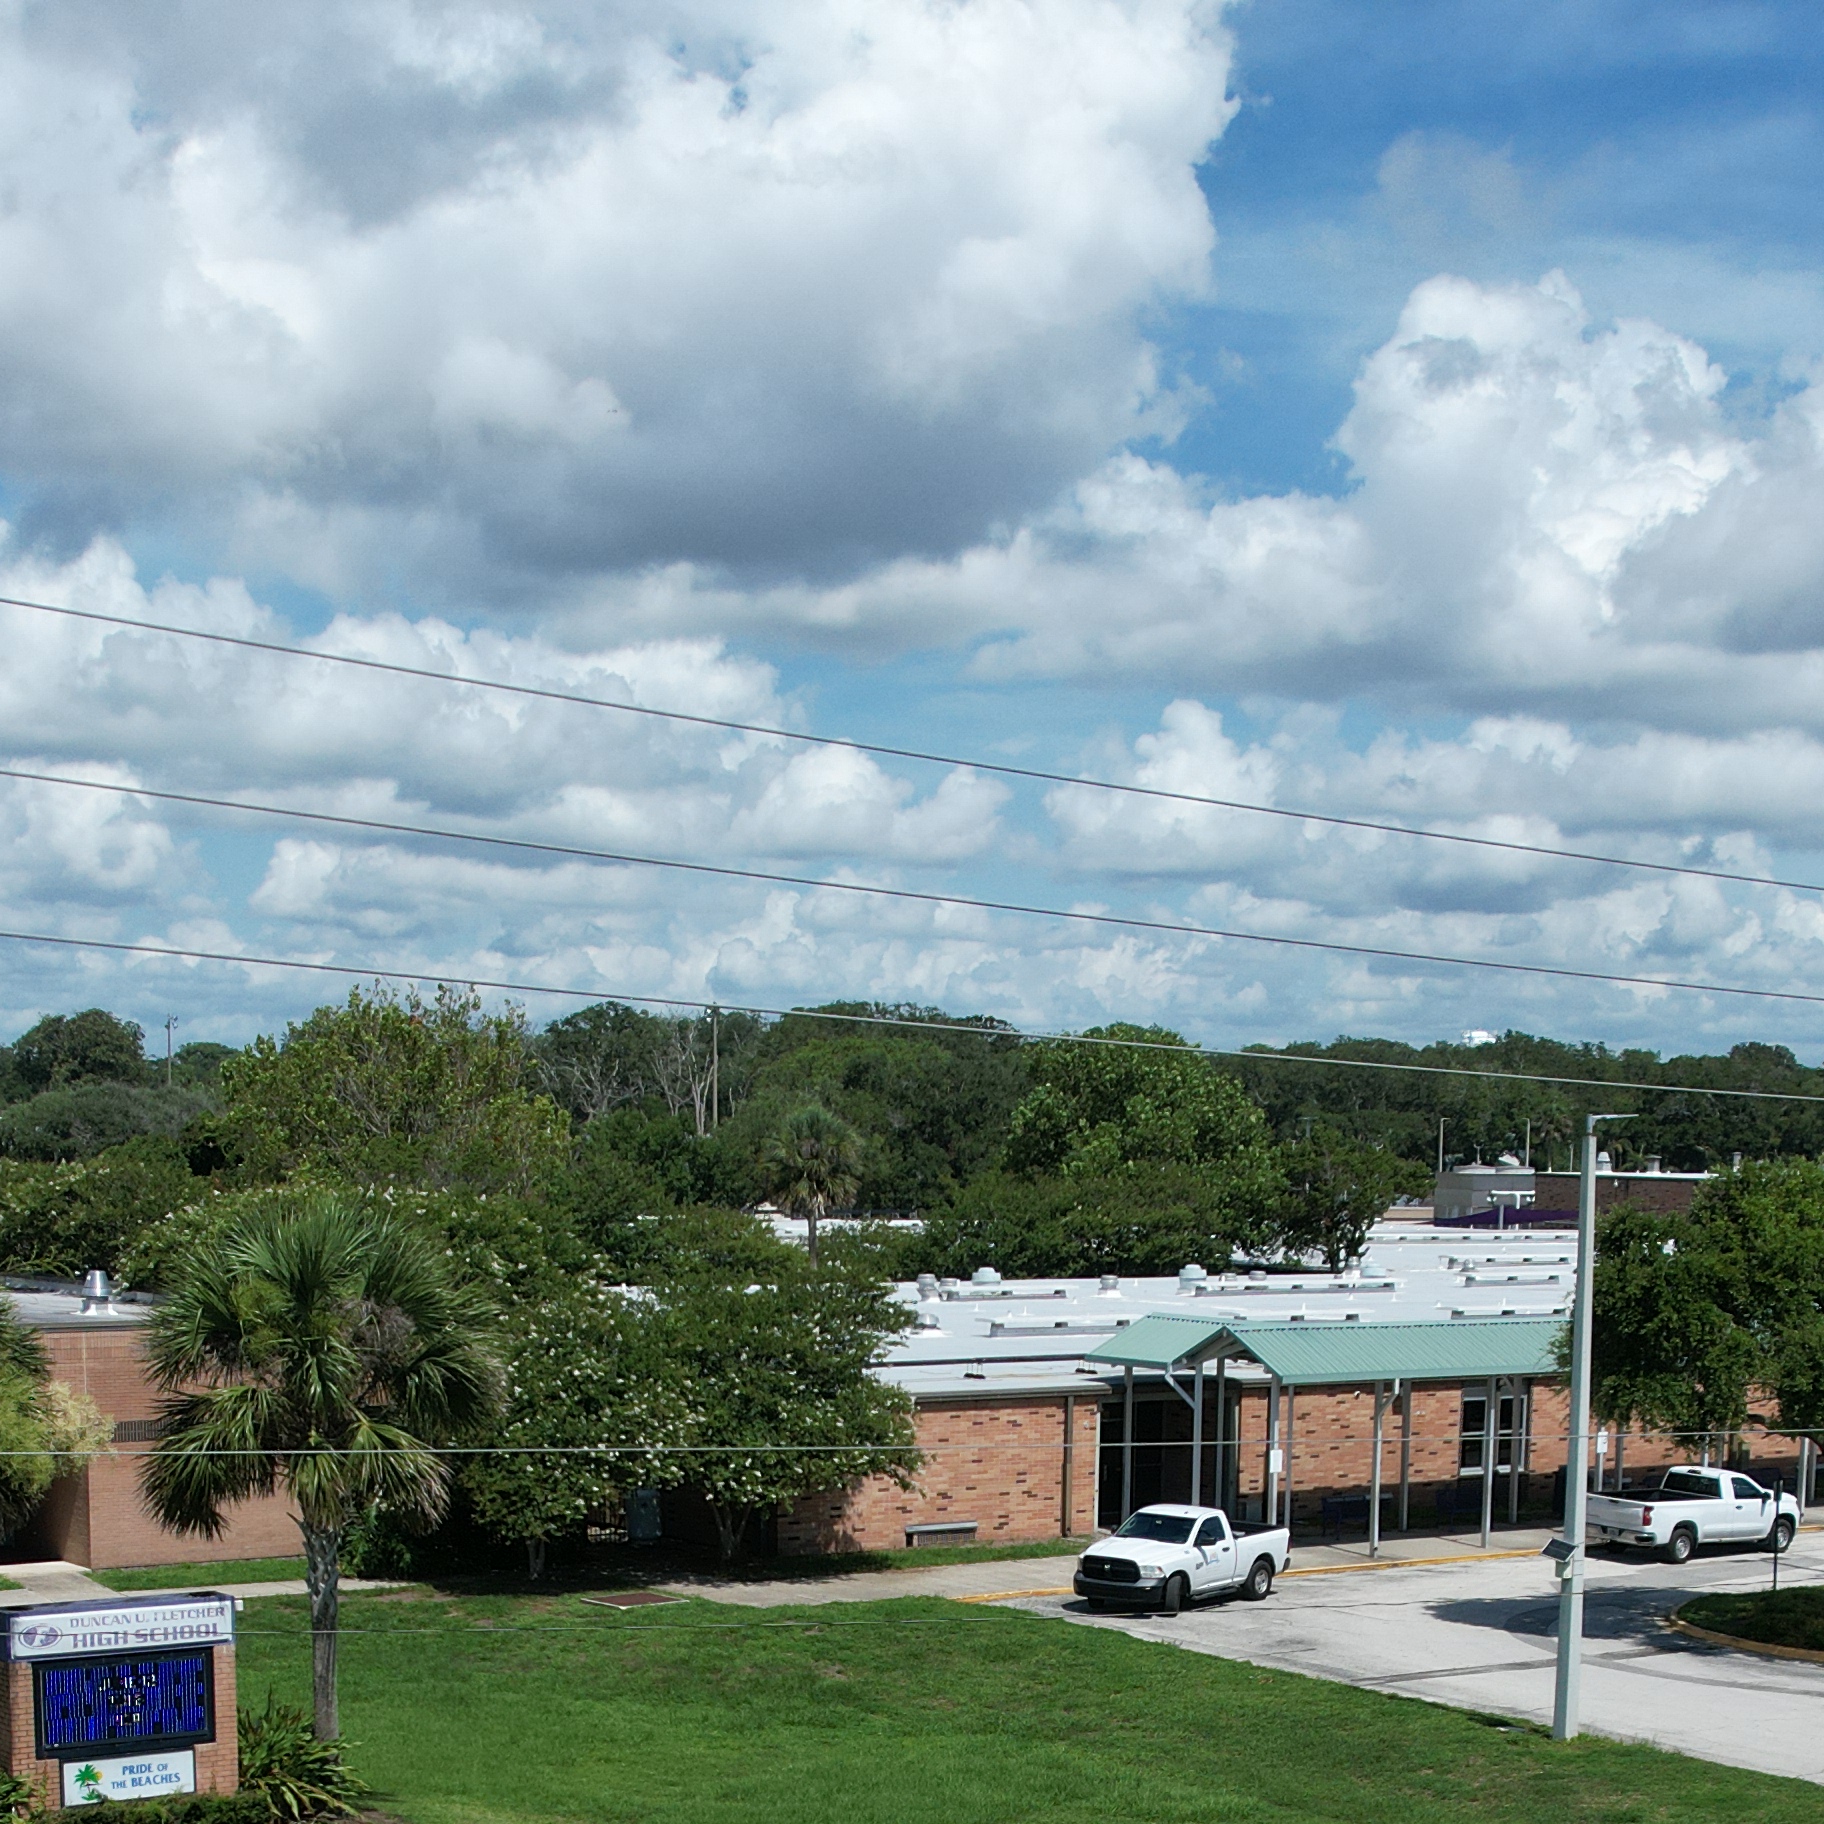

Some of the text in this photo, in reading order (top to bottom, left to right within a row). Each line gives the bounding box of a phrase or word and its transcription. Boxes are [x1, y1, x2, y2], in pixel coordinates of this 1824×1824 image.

[70, 1614, 132, 1628] DUNCAN
[71, 1622, 223, 1649] HIGH SCHOOL
[122, 1763, 168, 1776] PRIDE OF
[111, 1772, 181, 1789] THE BEACHES
